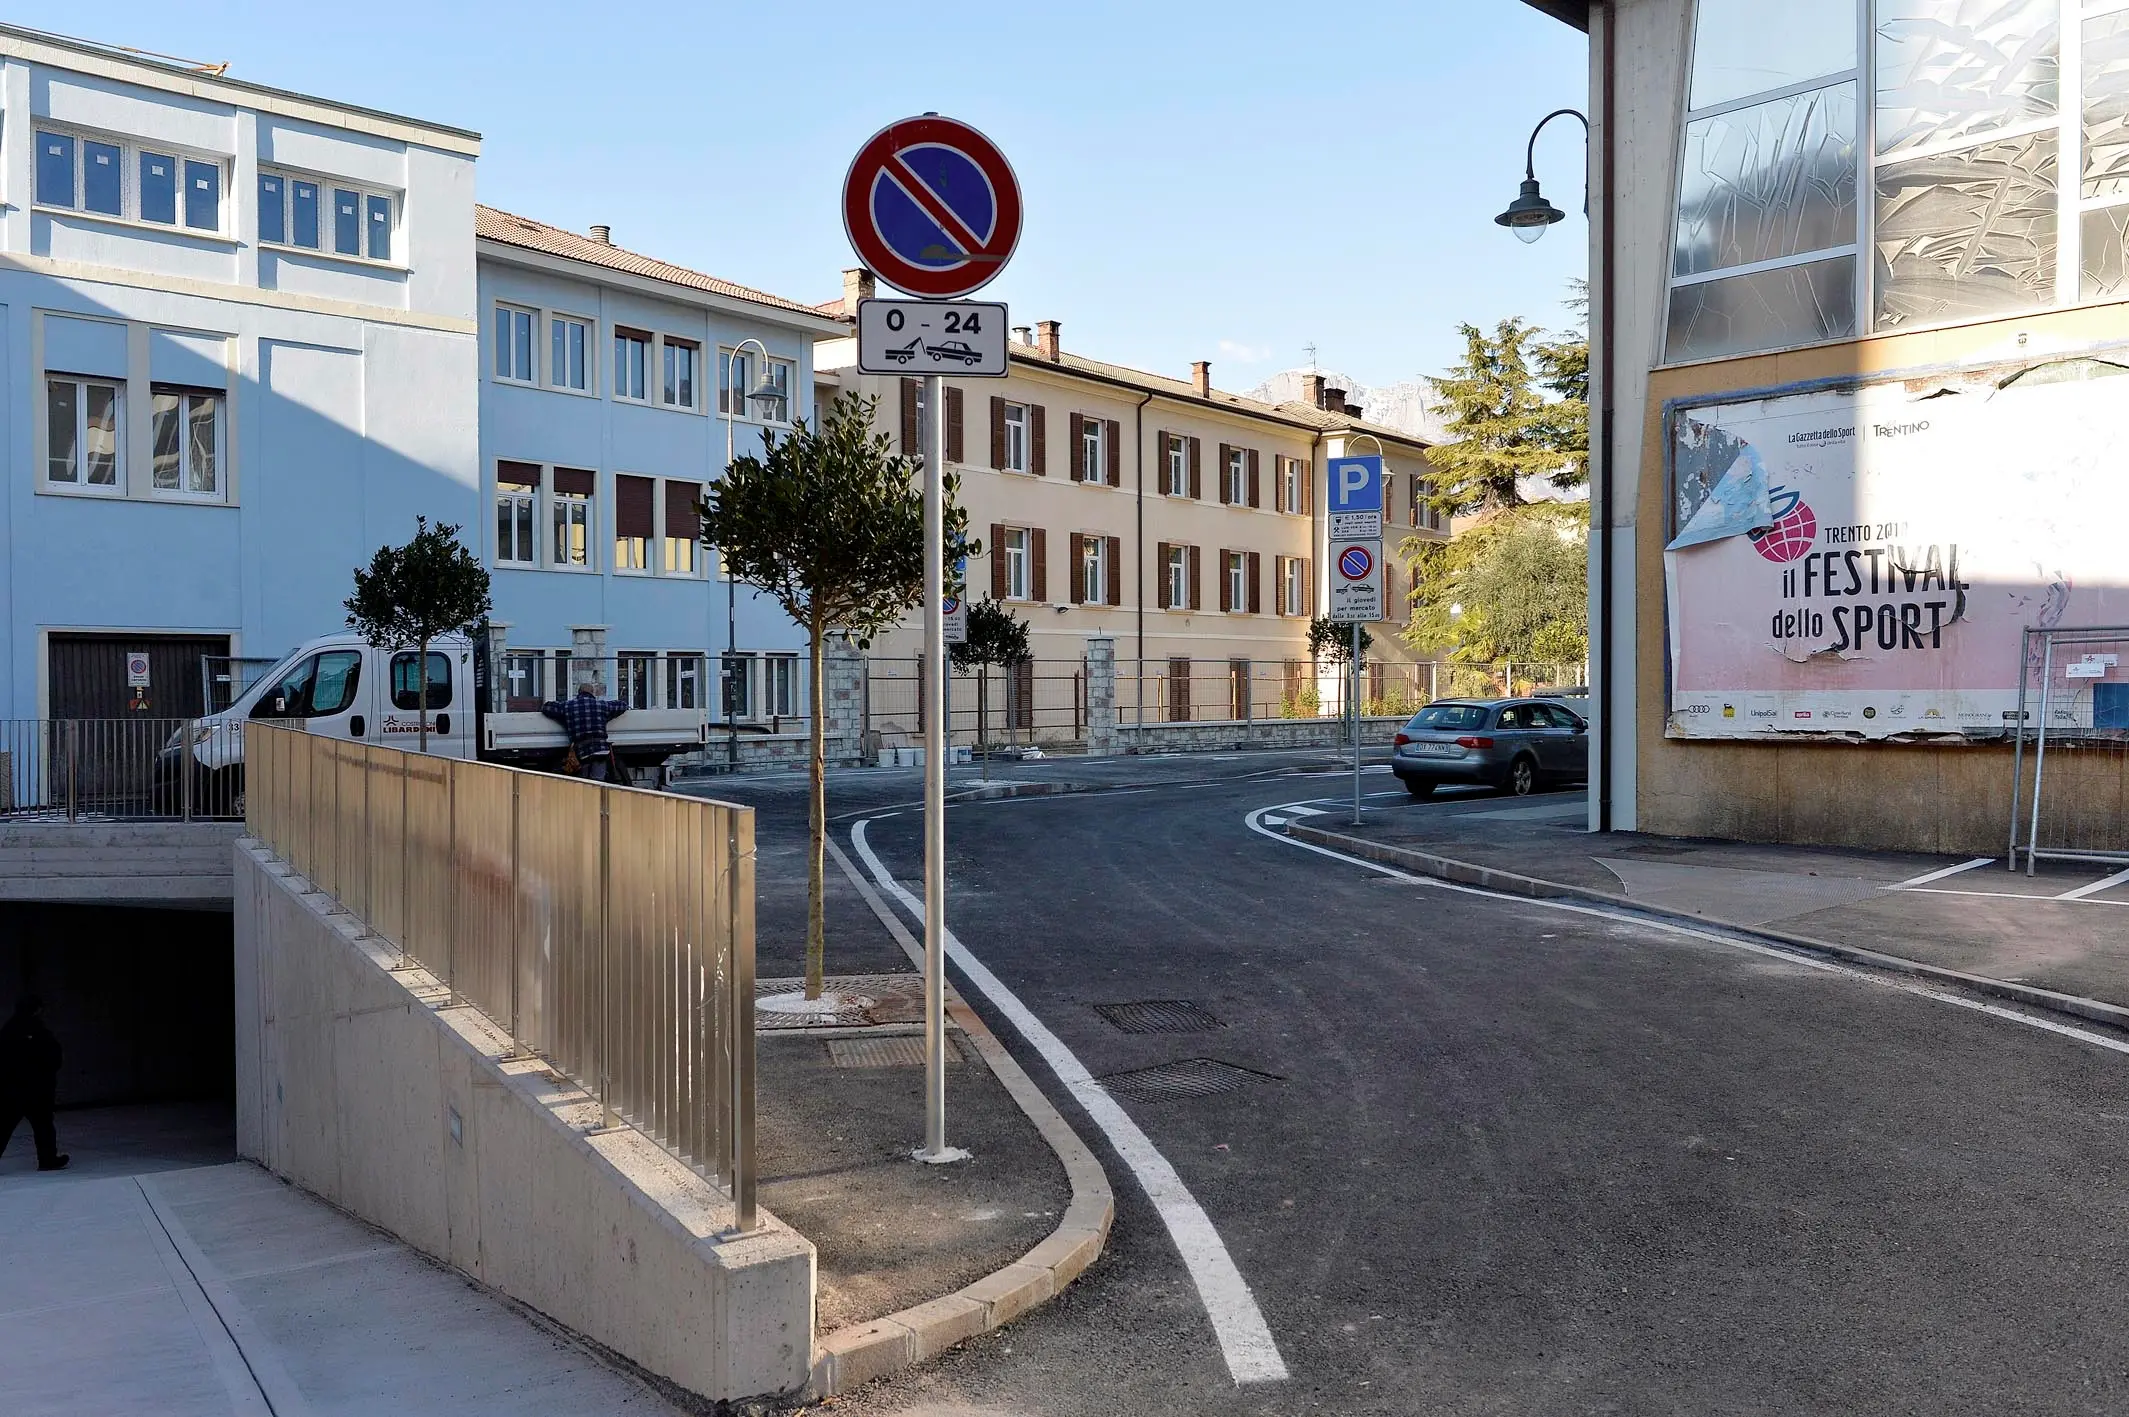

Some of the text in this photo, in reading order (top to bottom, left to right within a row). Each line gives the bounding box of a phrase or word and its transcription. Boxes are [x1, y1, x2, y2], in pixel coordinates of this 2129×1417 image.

[886, 309, 905, 332] 0
[944, 311, 982, 334] 24
[1796, 430, 1822, 443] Gazzetta
[1823, 428, 1838, 439] dello
[1838, 426, 1856, 439] Sport
[1340, 464, 1369, 504] P
[1825, 525, 1870, 543] TRENTO
[1783, 544, 1969, 598] il FESTIVAL
[1772, 602, 1946, 650] dello SPORT
